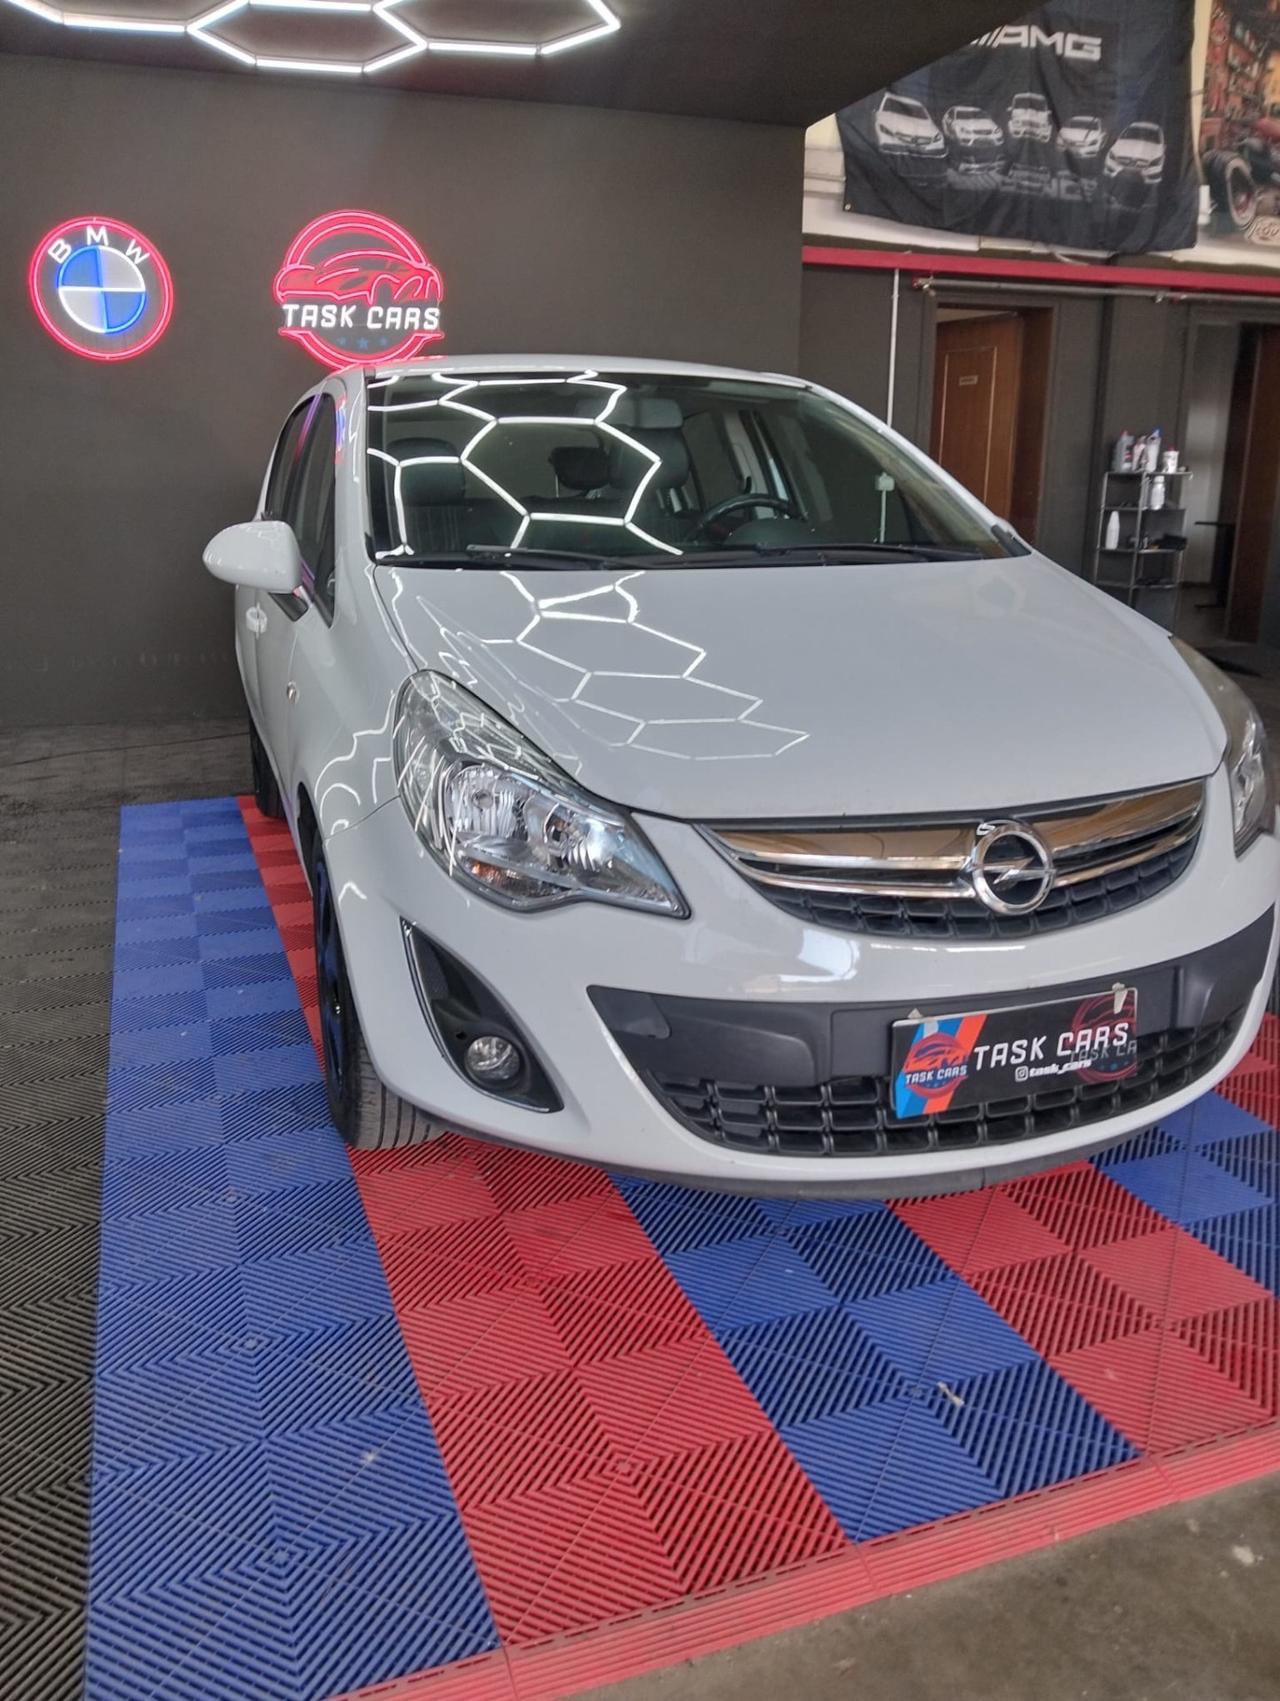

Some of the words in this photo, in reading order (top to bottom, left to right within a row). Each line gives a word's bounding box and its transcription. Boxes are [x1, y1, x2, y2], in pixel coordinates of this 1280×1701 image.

[47, 225, 151, 264] BMW
[282, 303, 356, 328] TASK
[366, 305, 441, 330] CARS
[973, 1035, 1047, 1071] TASK
[1056, 1022, 1129, 1056] CARS
[905, 1070, 934, 1085] TASK
[936, 1065, 968, 1081] CARS
